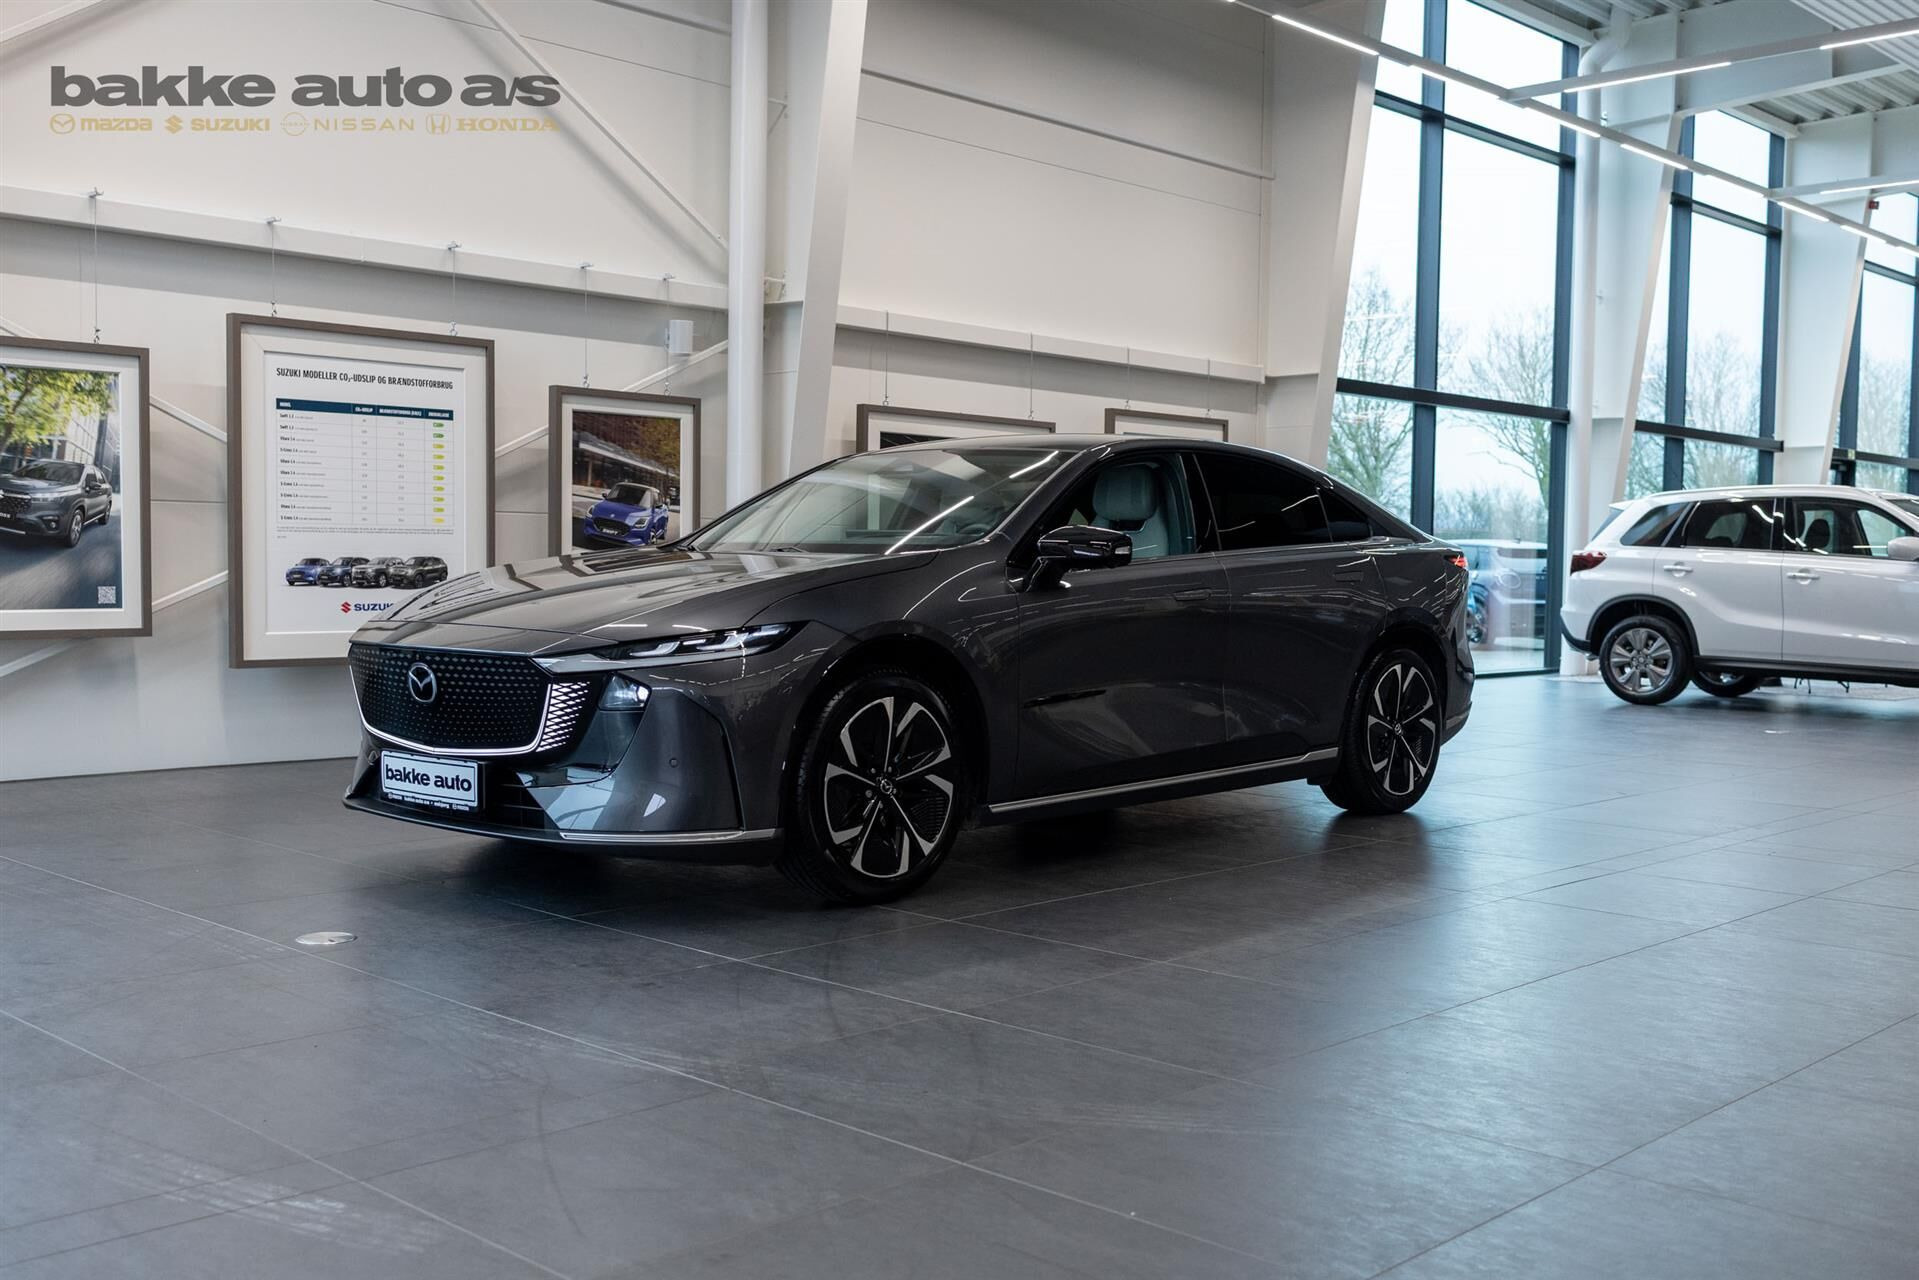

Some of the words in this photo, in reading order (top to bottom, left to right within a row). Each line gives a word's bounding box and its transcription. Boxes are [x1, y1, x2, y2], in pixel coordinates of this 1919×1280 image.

[276, 368, 301, 378] SUZUKI
[302, 370, 338, 380] MODELLER
[377, 375, 387, 384] OG
[388, 376, 453, 390] BRÆNDSTOFFORBRUG
[385, 764, 430, 786] bakke
[434, 774, 472, 792] auto
